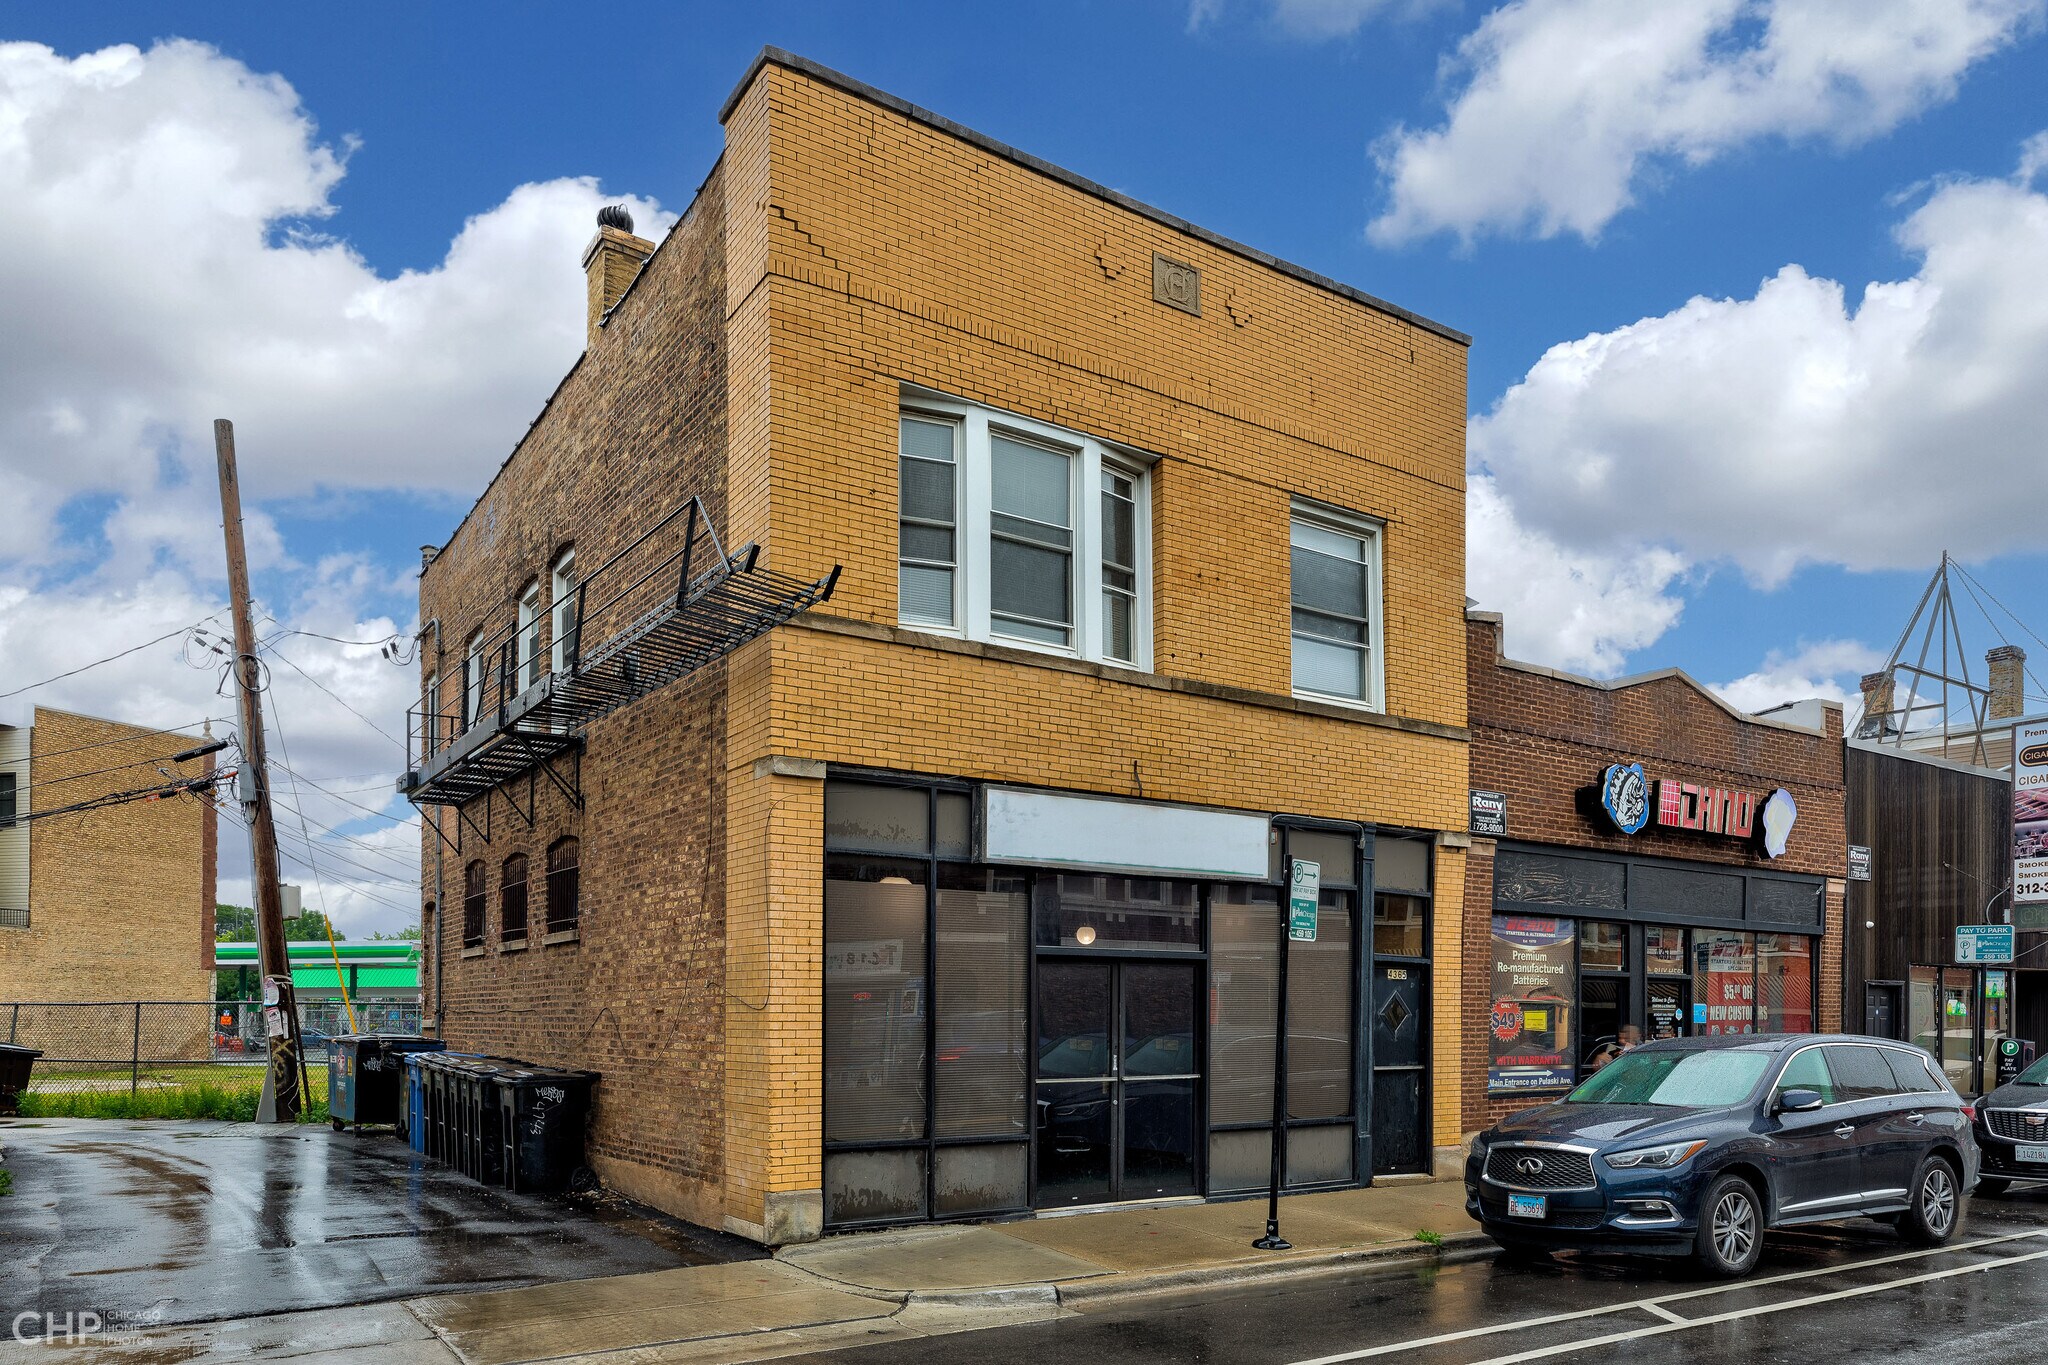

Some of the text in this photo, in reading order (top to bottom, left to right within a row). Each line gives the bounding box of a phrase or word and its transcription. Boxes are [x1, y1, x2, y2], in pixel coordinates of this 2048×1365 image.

[1472, 796, 1503, 811] Rany
[1850, 850, 1869, 860] Rany
[1512, 950, 1547, 961] Premium
[1497, 962, 1564, 974] Re-manufactured
[1388, 970, 1407, 979] 4365
[1513, 975, 1549, 985] Batteries
[1710, 1005, 1726, 1020] NEW
[1495, 1055, 1562, 1065] WITH WARRANTY!
[1505, 1078, 1529, 1086] Entrance
